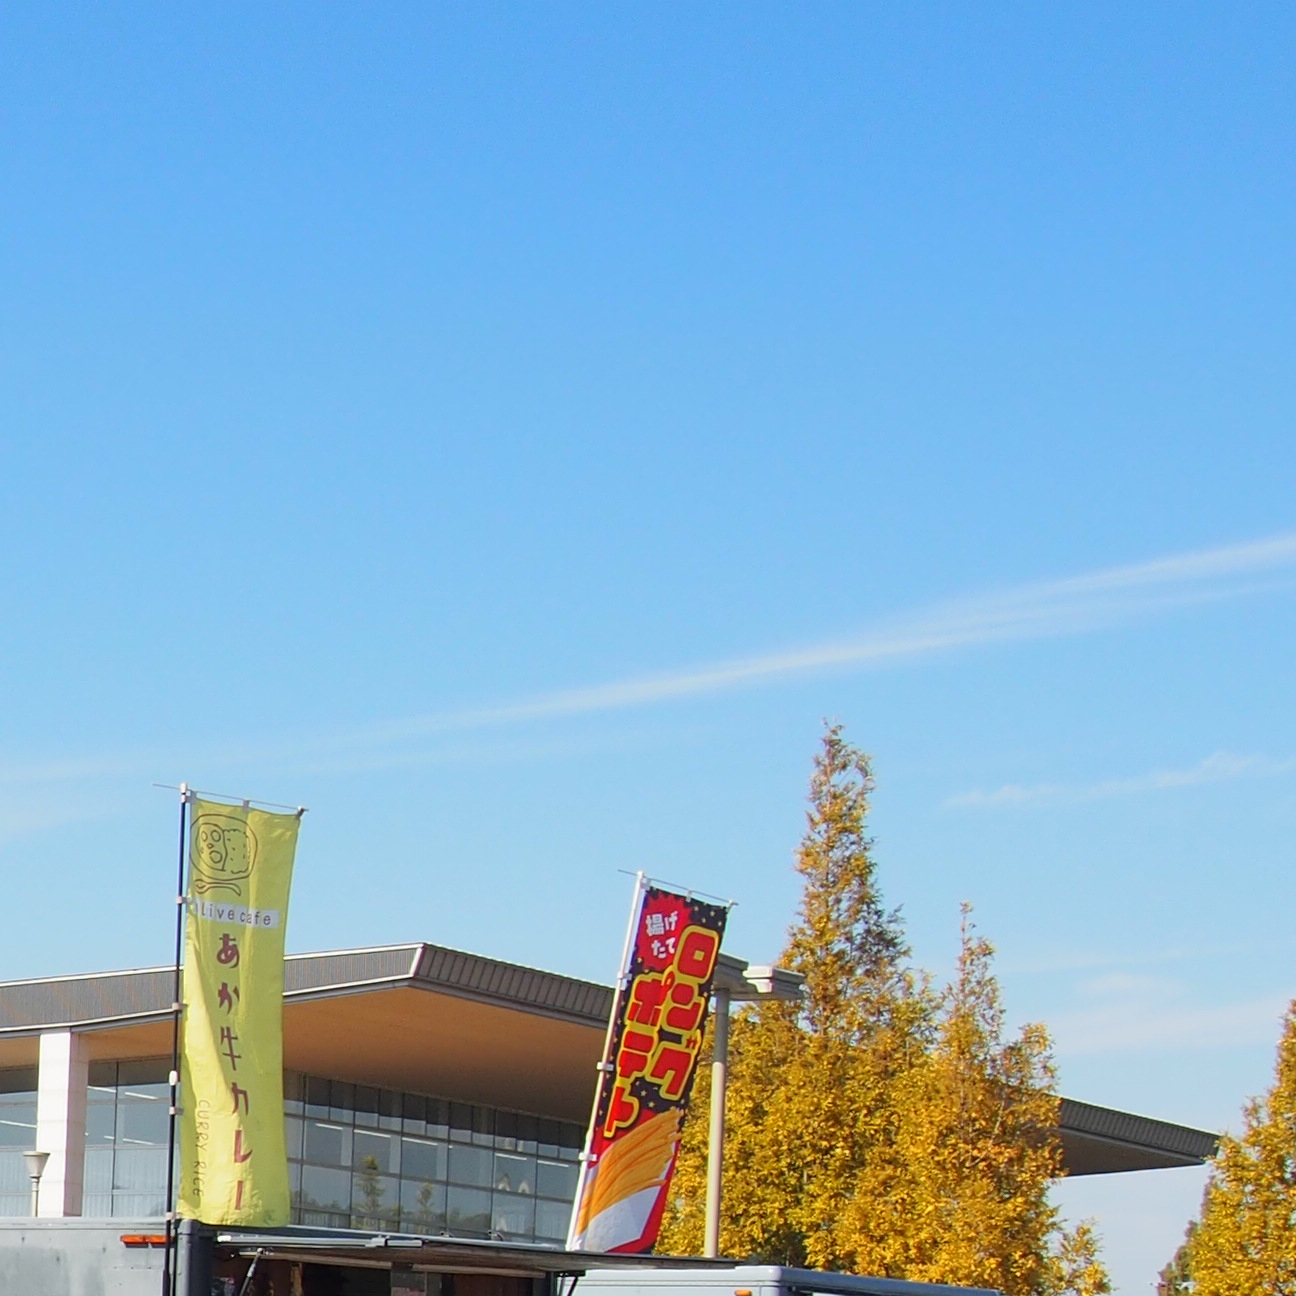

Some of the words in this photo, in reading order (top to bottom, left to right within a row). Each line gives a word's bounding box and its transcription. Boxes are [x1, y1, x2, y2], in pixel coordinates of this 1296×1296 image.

[195, 902, 235, 921] live
[239, 910, 271, 926] cafe
[645, 911, 678, 937] 揚げ
[651, 937, 677, 959] たて
[647, 927, 718, 1100] ロング
[216, 934, 253, 1211] あか牛カレー
[195, 1099, 211, 1152] CURRY
[192, 1161, 207, 1197] RICE
